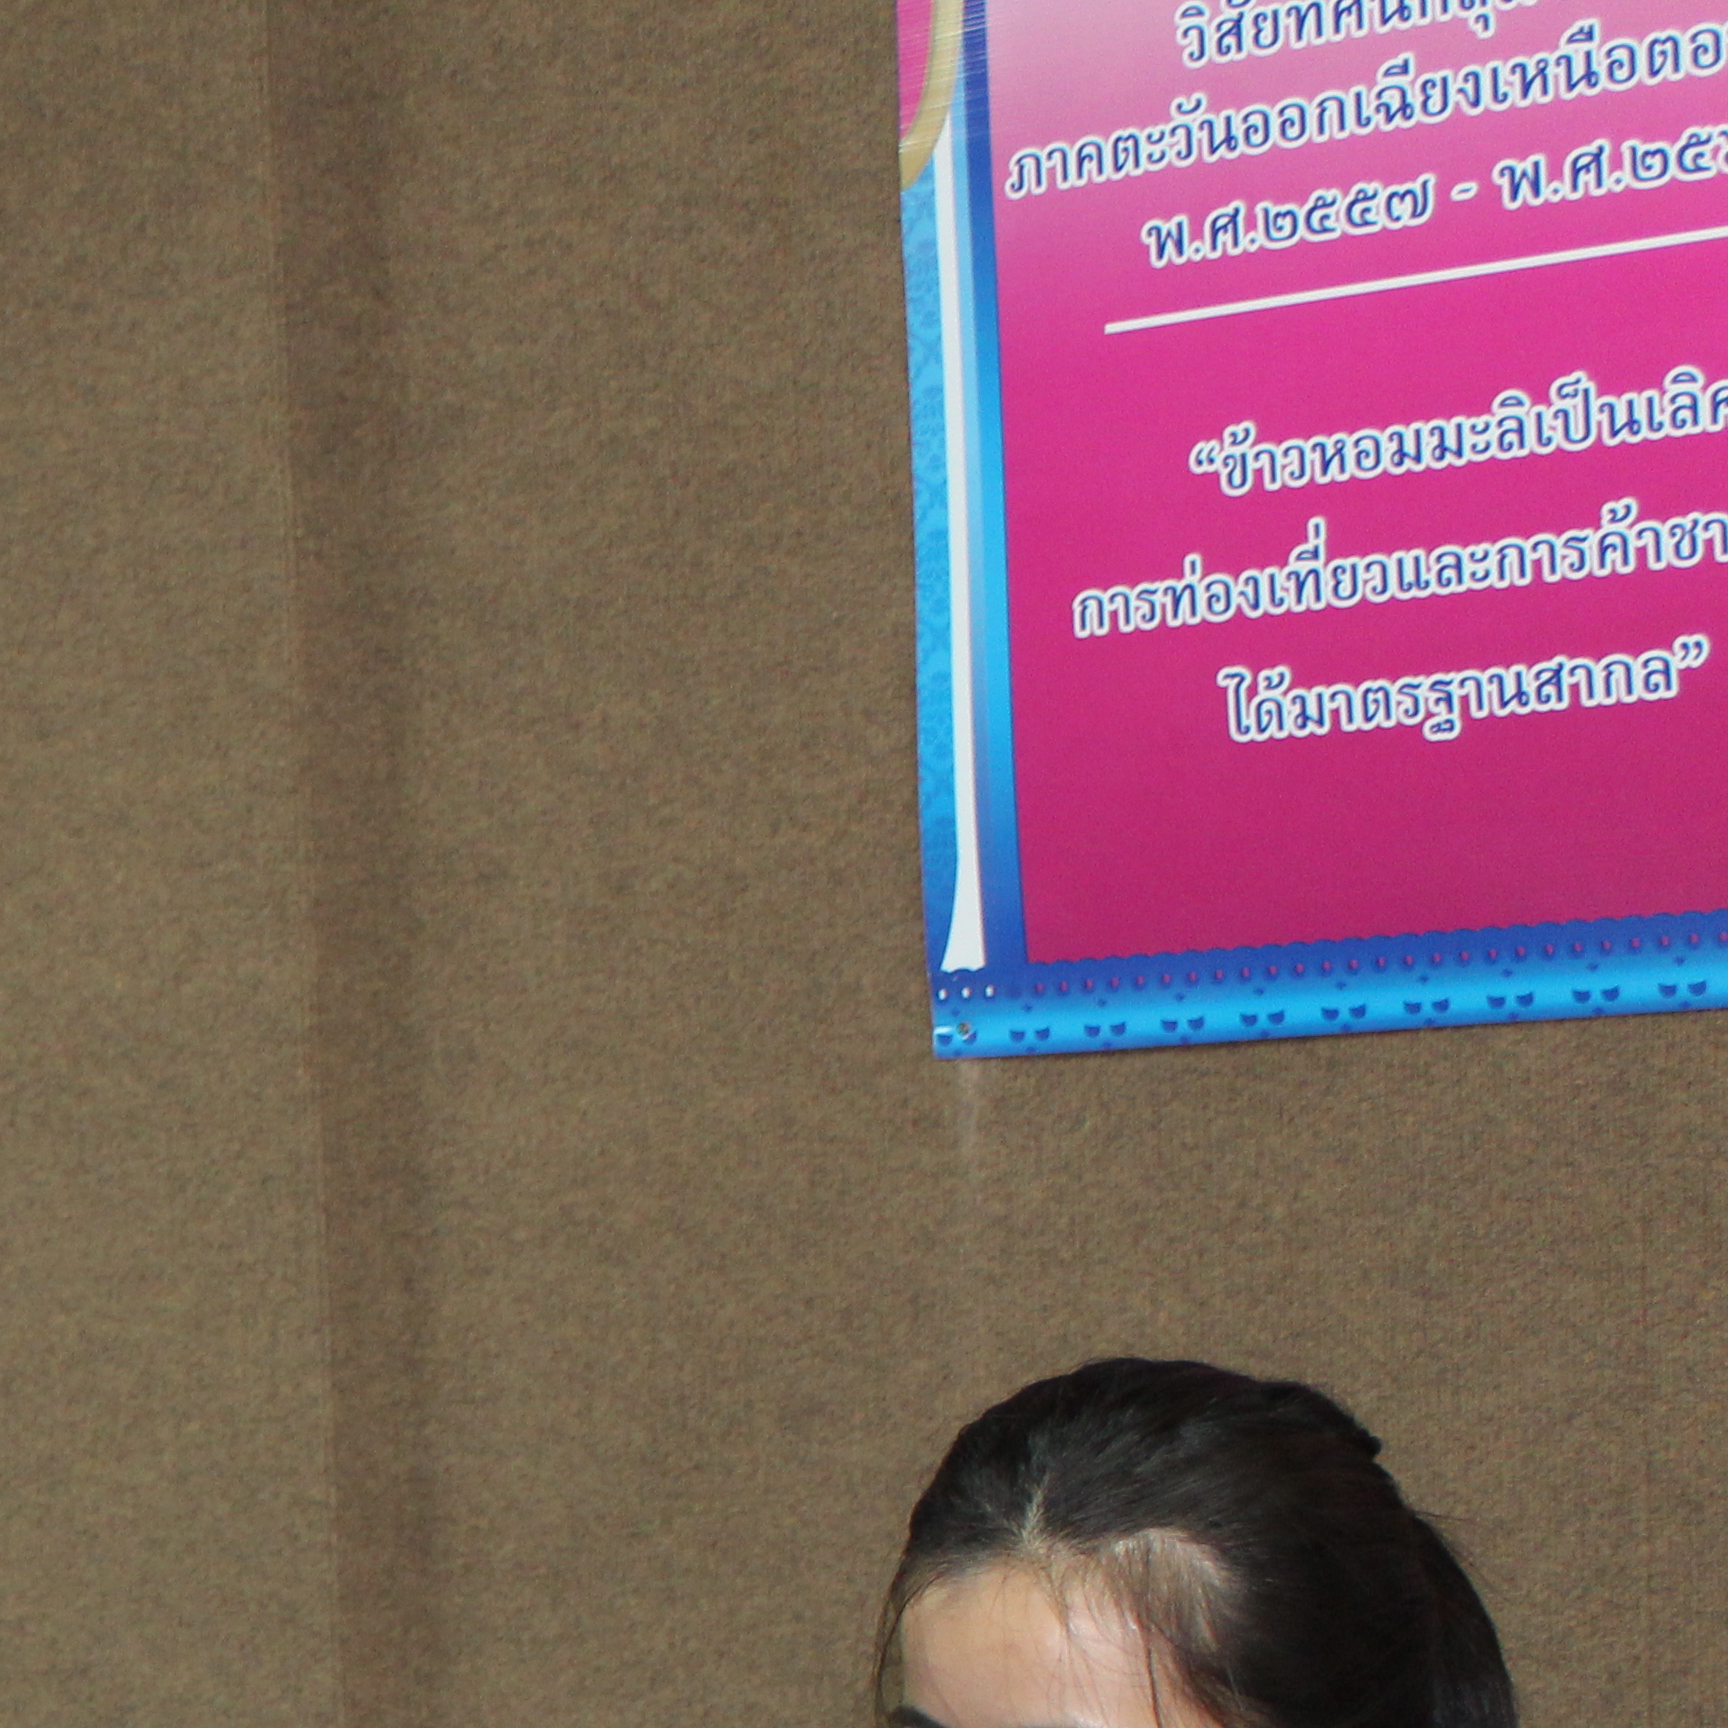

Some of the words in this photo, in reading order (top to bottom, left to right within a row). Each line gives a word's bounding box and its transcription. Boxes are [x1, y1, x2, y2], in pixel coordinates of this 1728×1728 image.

[1005, 20, 1728, 199] ภาคตะวันออกเฉียงเหนือตอ
[1141, 171, 1433, 269] พ.ศ.๒๕๕๗
[1494, 123, 1728, 210] พ.ศ.๒๕
[1218, 635, 1709, 740] ได้มาตรฐานสากล”
